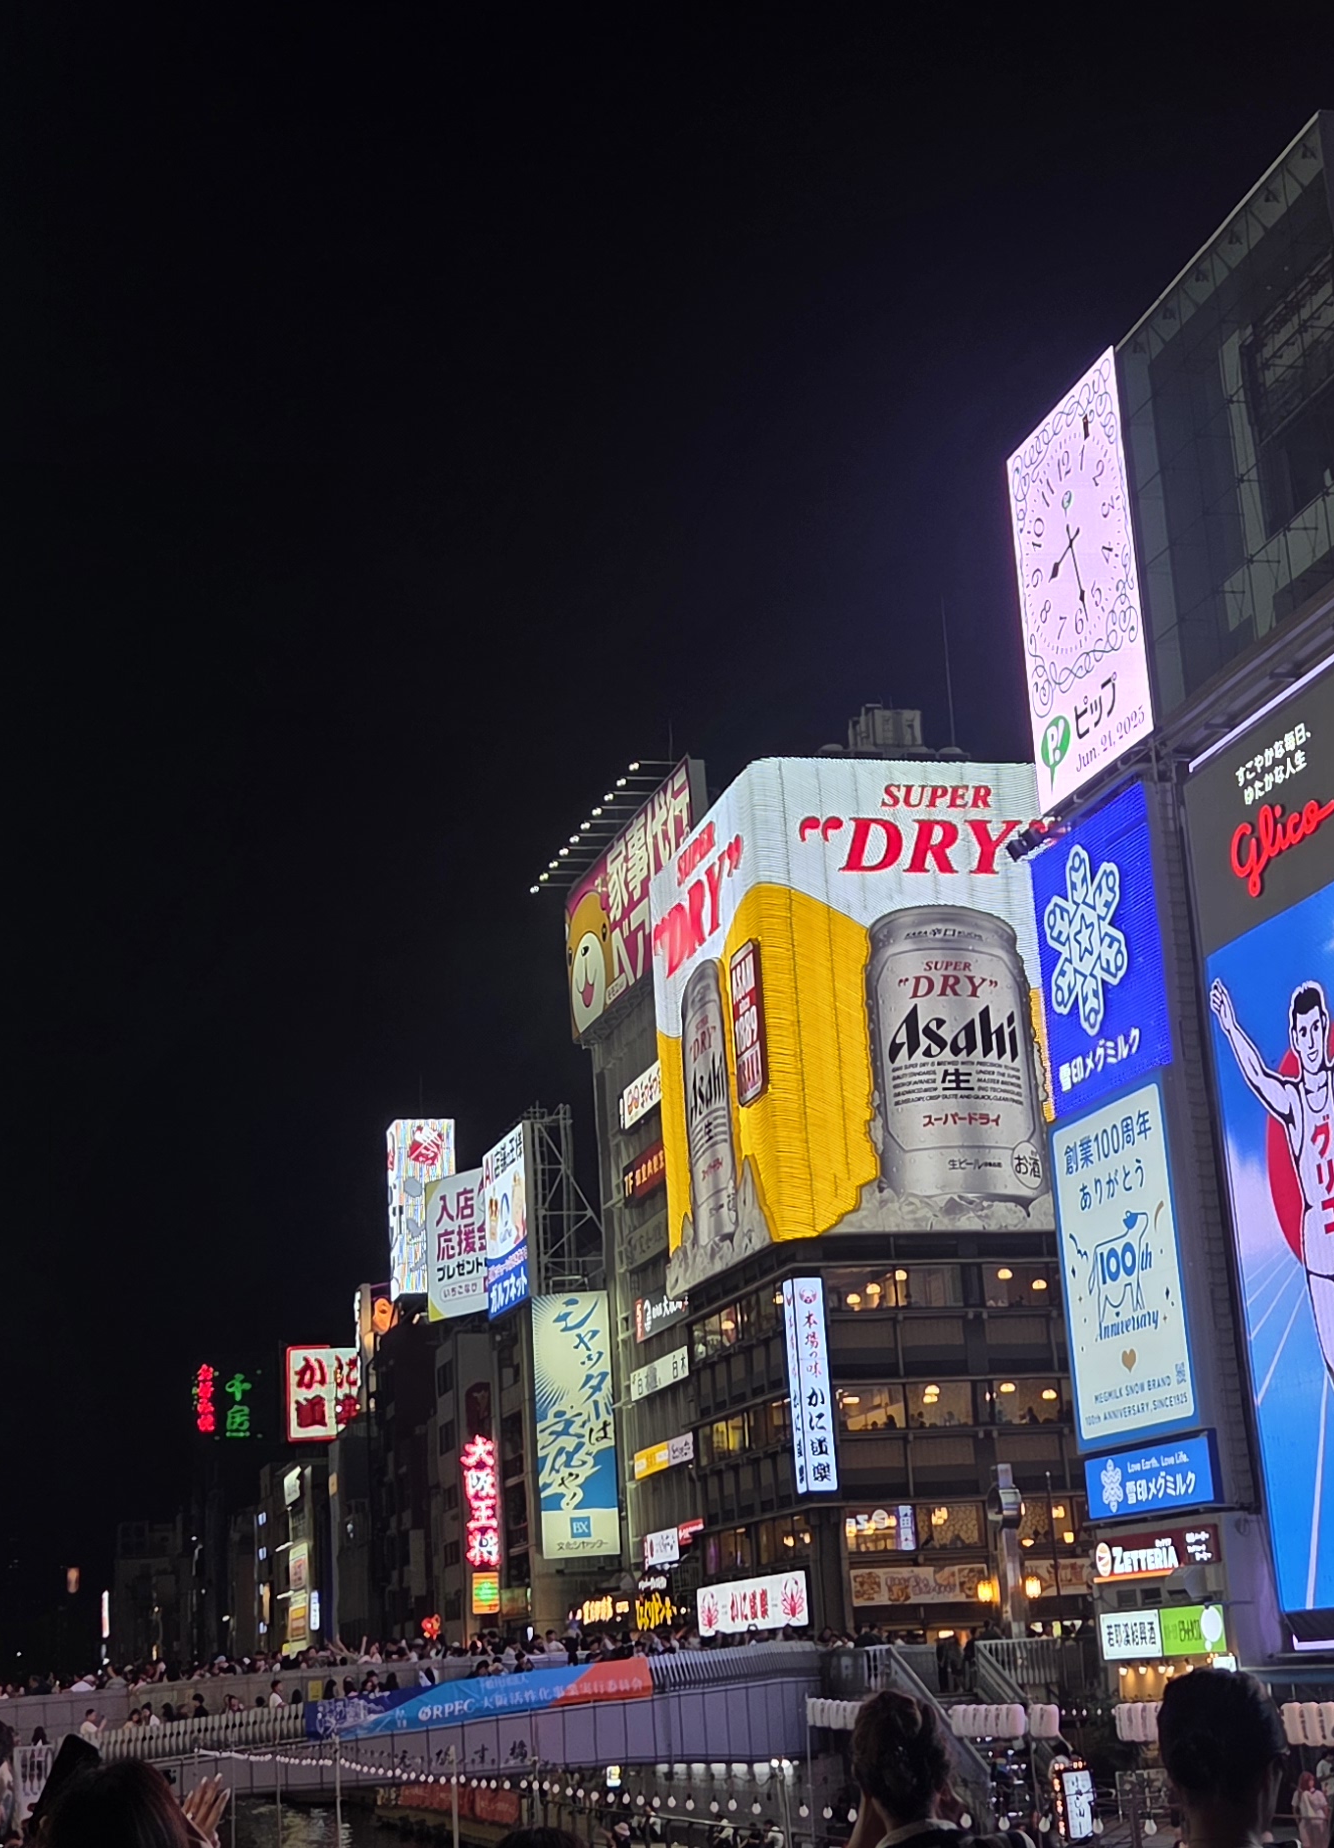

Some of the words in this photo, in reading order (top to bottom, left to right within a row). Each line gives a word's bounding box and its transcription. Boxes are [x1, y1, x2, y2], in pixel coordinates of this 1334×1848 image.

[1056, 449, 1071, 482] 12
[1078, 445, 1085, 471] 1
[1092, 459, 1105, 487] 2
[1040, 478, 1055, 508] 11
[1100, 501, 1115, 518] 3
[1031, 517, 1045, 553] 10
[1101, 545, 1114, 564] 4
[1030, 567, 1044, 589] 9
[1091, 581, 1102, 608] 5
[1038, 599, 1052, 624] 8
[1074, 607, 1084, 636] 6
[1056, 616, 1068, 640] 7
[1073, 671, 1118, 740] ピップ
[1075, 748, 1100, 774] Jun.
[1115, 704, 1146, 740] 2025
[1243, 750, 1308, 805] ゆたかな人生
[881, 783, 992, 811] SUPER
[924, 960, 972, 973] SUPER
[889, 1003, 1019, 1065] Asahi
[941, 1068, 975, 1092] 生
[922, 1113, 1001, 1127] スーパードライ
[1064, 1109, 1152, 1176] 創業100周年
[1014, 1154, 1041, 1179] お酒
[1079, 1158, 1146, 1212] ありがとう
[435, 1187, 475, 1228] 入店
[1099, 1240, 1154, 1286] 100th
[1125, 1382, 1145, 1397] SNOW
[1147, 1374, 1172, 1393] BRAND
[1127, 1461, 1140, 1473] Love
[1141, 1458, 1159, 1472] Earth.
[1161, 1456, 1174, 1468] Love
[1125, 1470, 1196, 1504] 雪印メグミルク
[572, 1520, 589, 1534] BX
[1112, 1546, 1179, 1574] ZETTERIA
